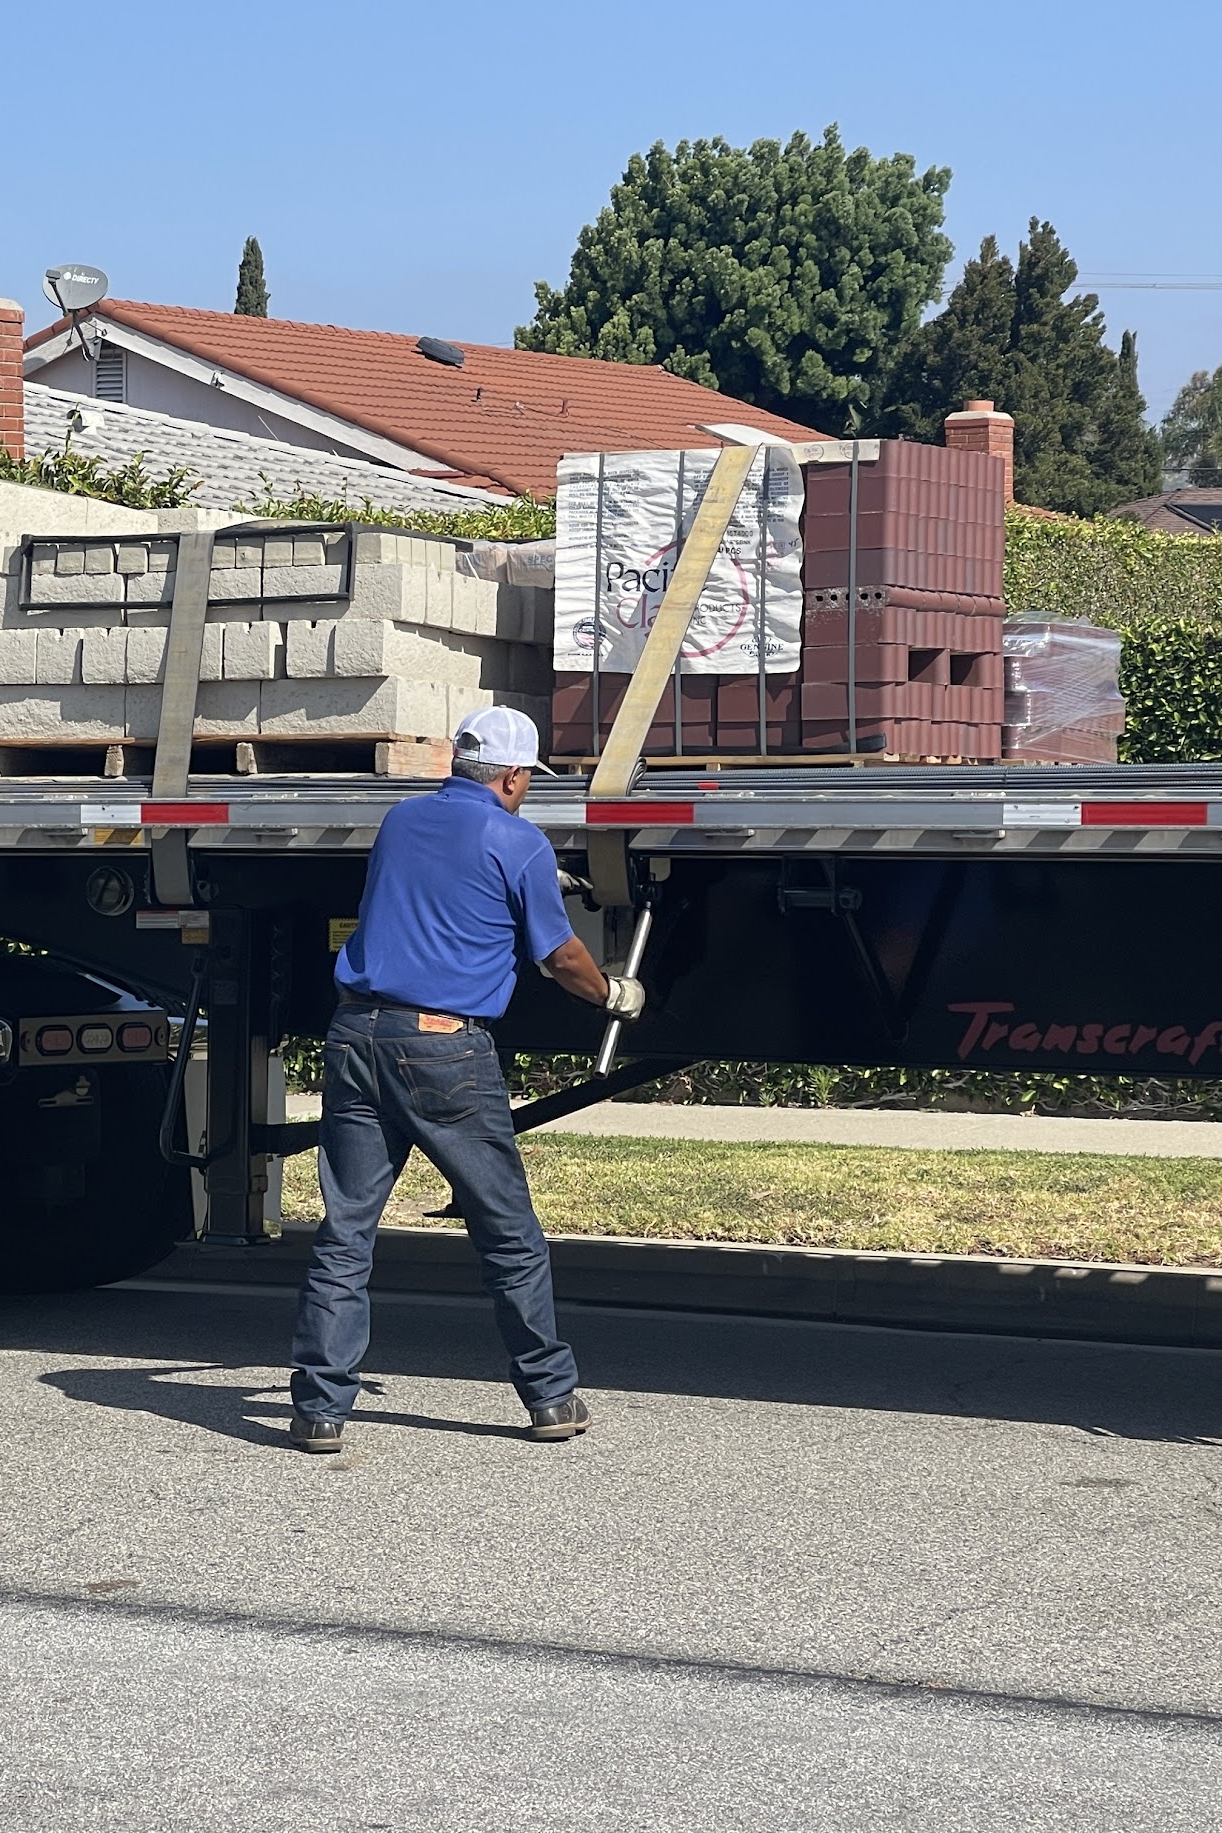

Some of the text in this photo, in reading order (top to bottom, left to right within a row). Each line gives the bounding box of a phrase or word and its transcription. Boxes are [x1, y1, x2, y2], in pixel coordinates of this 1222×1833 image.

[72, 273, 100, 284] DIRECTV
[606, 561, 709, 592] Paci
[694, 603, 742, 613] RODUCTS
[692, 616, 707, 625] NC
[740, 643, 784, 651] GENINE
[947, 1001, 1222, 1067] Transcraf
